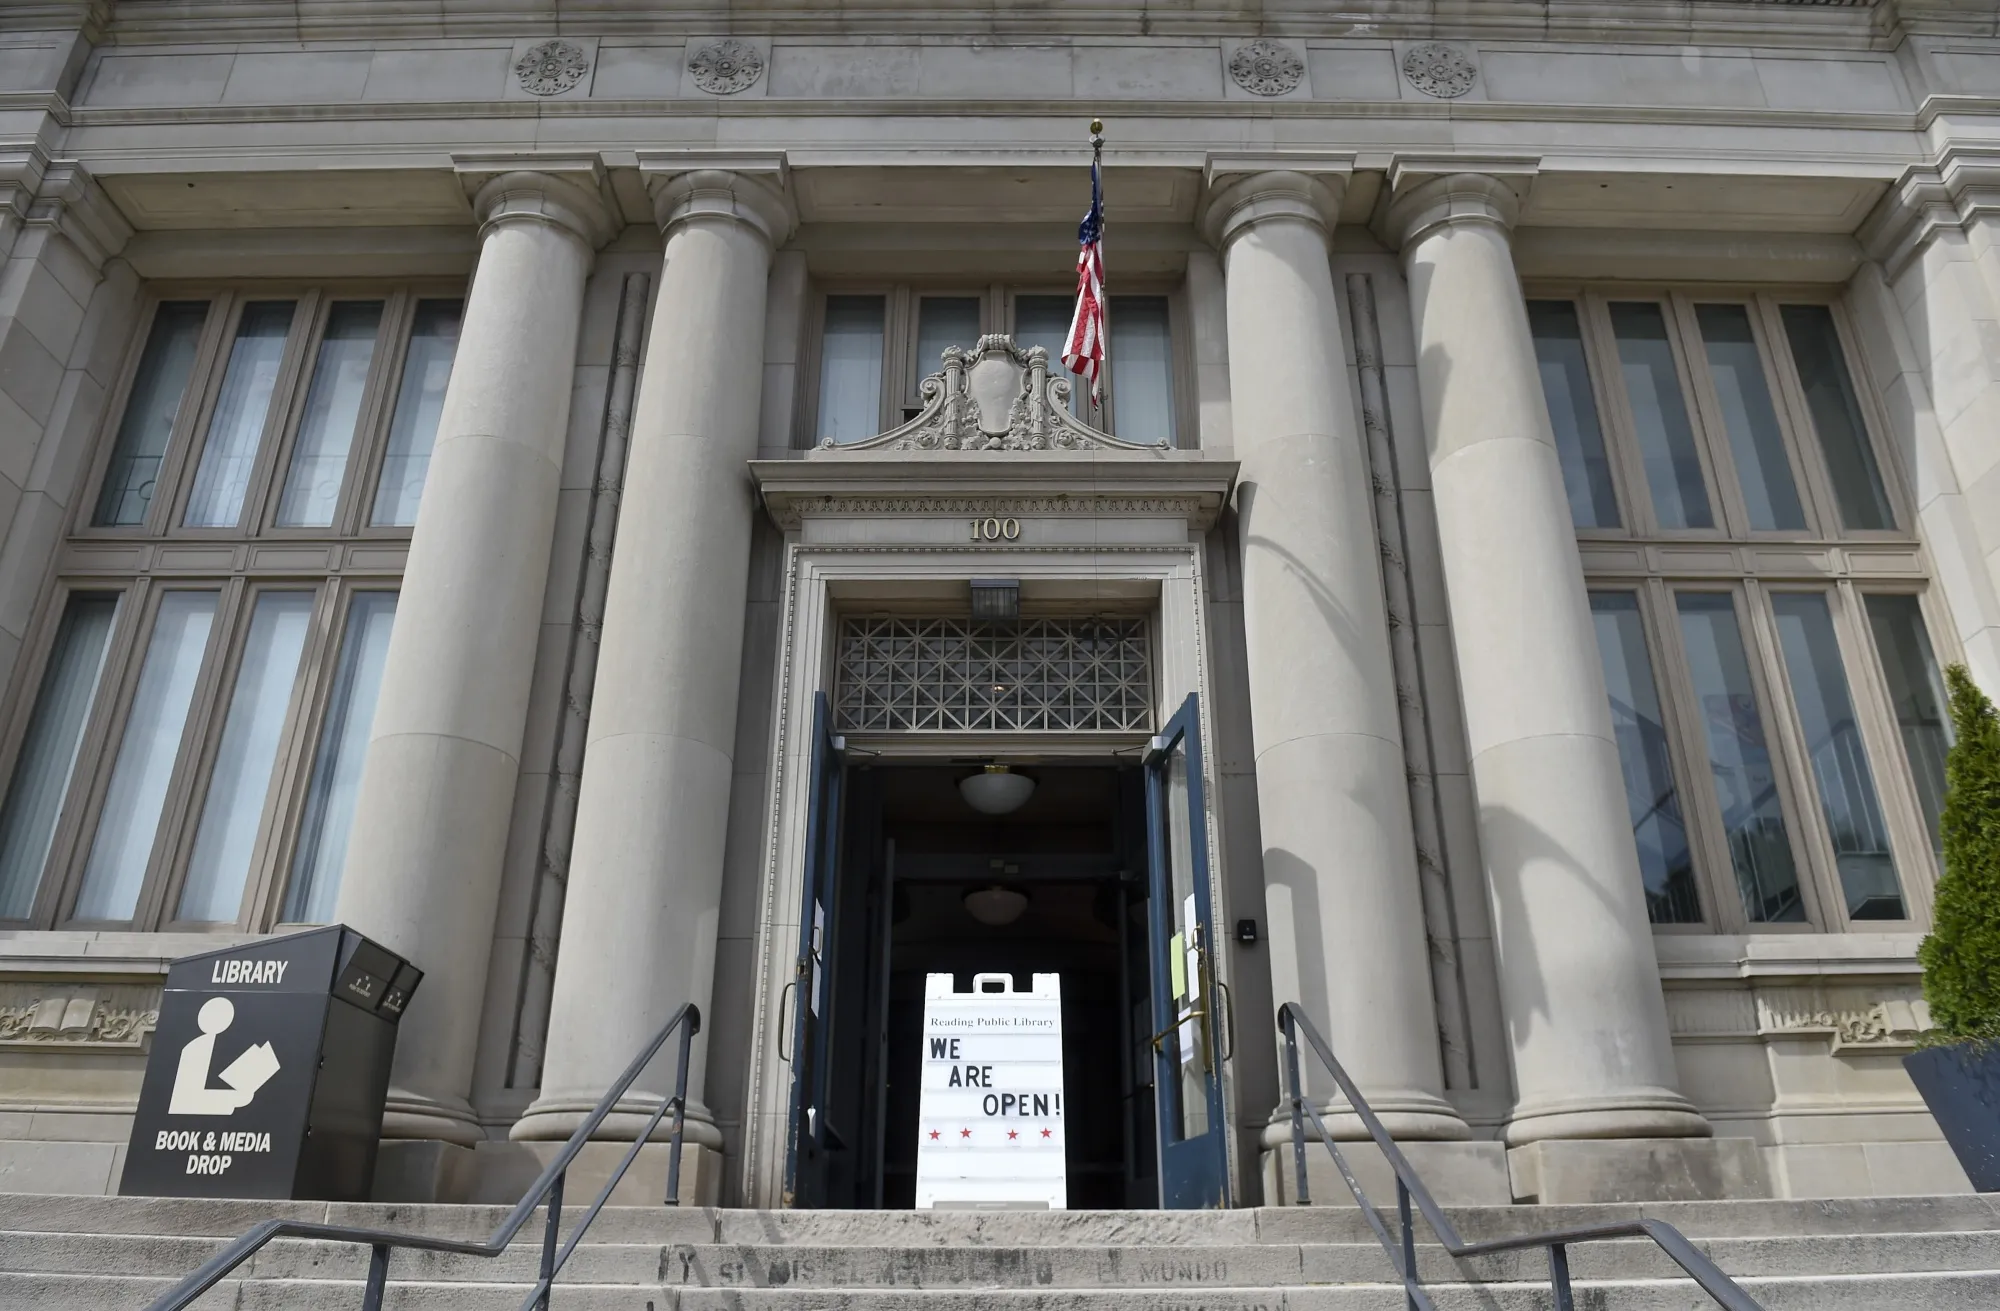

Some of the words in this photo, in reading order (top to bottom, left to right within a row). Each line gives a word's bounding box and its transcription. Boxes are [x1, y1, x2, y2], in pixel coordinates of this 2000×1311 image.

[970, 518, 1020, 540] 100
[211, 960, 288, 984] LIBRARY
[930, 1017, 974, 1028] Reading
[977, 1016, 1011, 1027] Public
[1013, 1016, 1055, 1028] Library
[930, 1038, 961, 1059] WE
[949, 1065, 993, 1088] ARE
[983, 1093, 1060, 1117] OPEN!
[155, 1130, 201, 1151] BOOK
[202, 1132, 216, 1151] &
[219, 1131, 271, 1152] MEDIA
[185, 1154, 232, 1175] DROP
[1138, 1260, 1228, 1283] MUNDO
